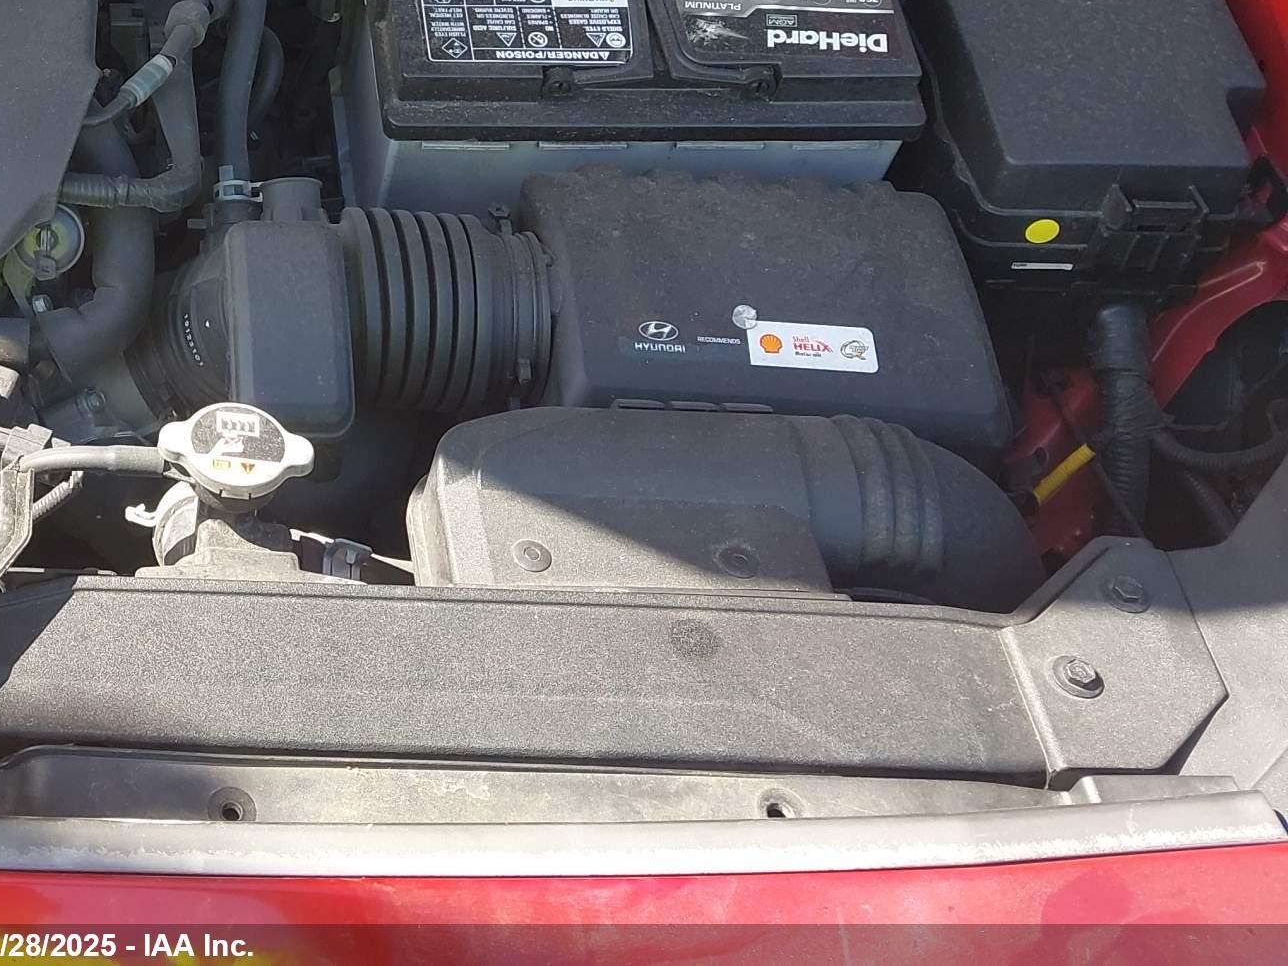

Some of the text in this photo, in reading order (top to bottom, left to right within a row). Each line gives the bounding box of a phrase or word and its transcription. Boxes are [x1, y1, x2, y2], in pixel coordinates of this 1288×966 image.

[684, 0, 742, 10] PLATINUM
[768, 18, 795, 26] AGM
[767, 28, 889, 53] DieHard
[496, 50, 599, 59] DANGER/POISON
[697, 336, 741, 345] RECOMMENDS
[634, 342, 686, 353] HYUNDAI
[793, 343, 830, 353] HELIX
